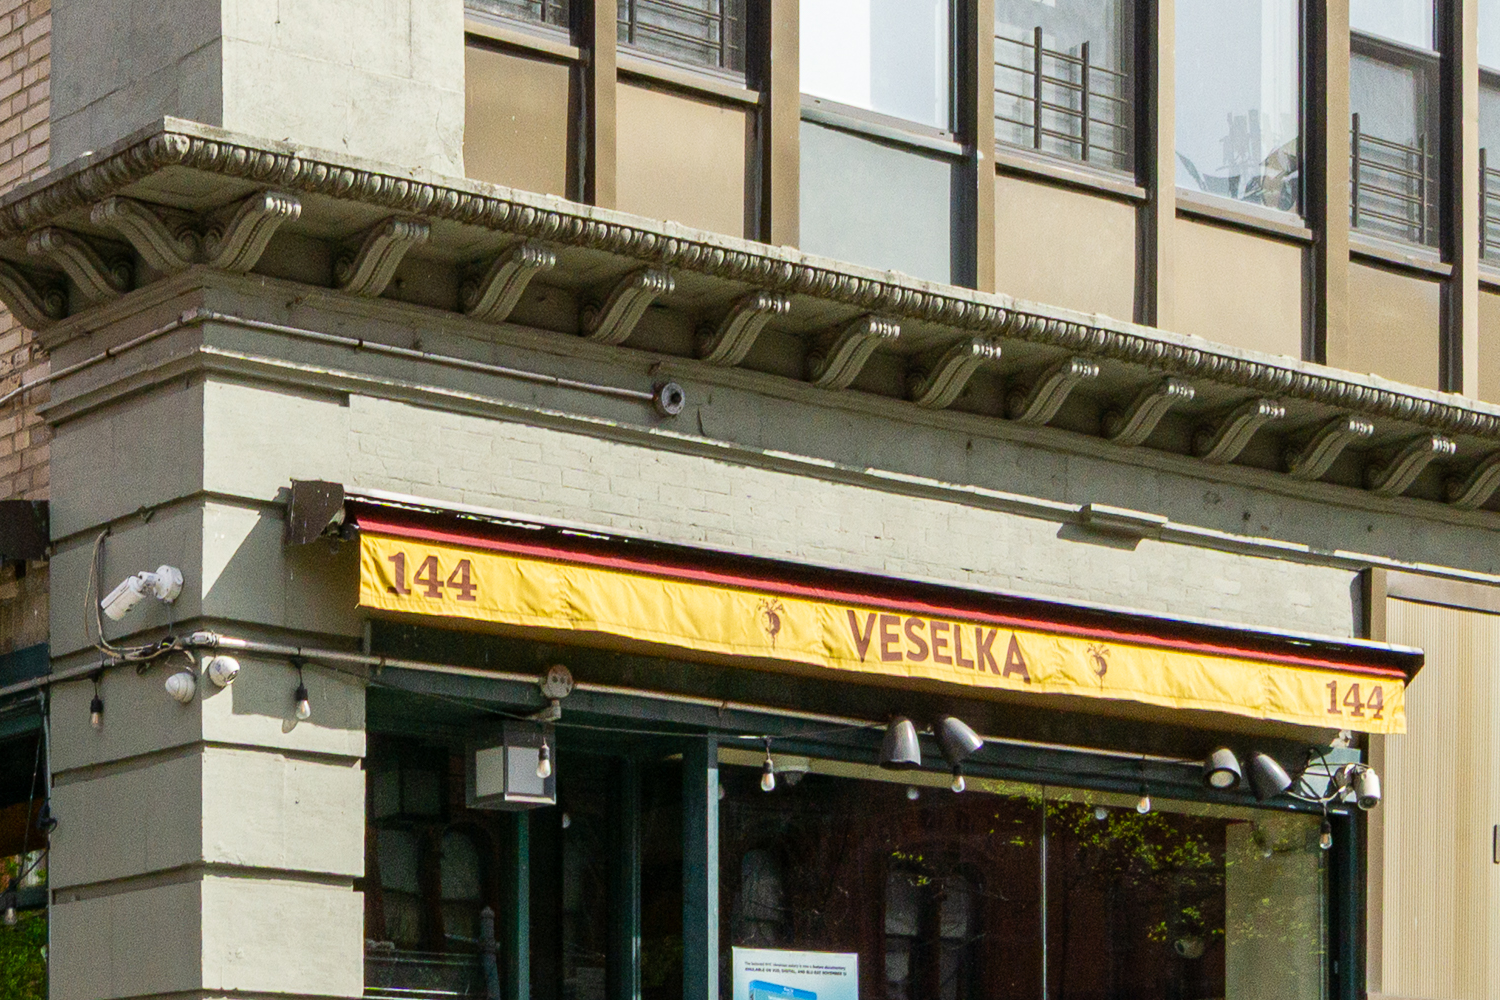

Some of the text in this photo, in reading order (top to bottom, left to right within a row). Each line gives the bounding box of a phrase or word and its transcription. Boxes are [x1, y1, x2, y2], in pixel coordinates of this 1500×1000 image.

[387, 552, 478, 602] 144
[847, 609, 1031, 683] VESELKA
[1325, 680, 1385, 720] 144
